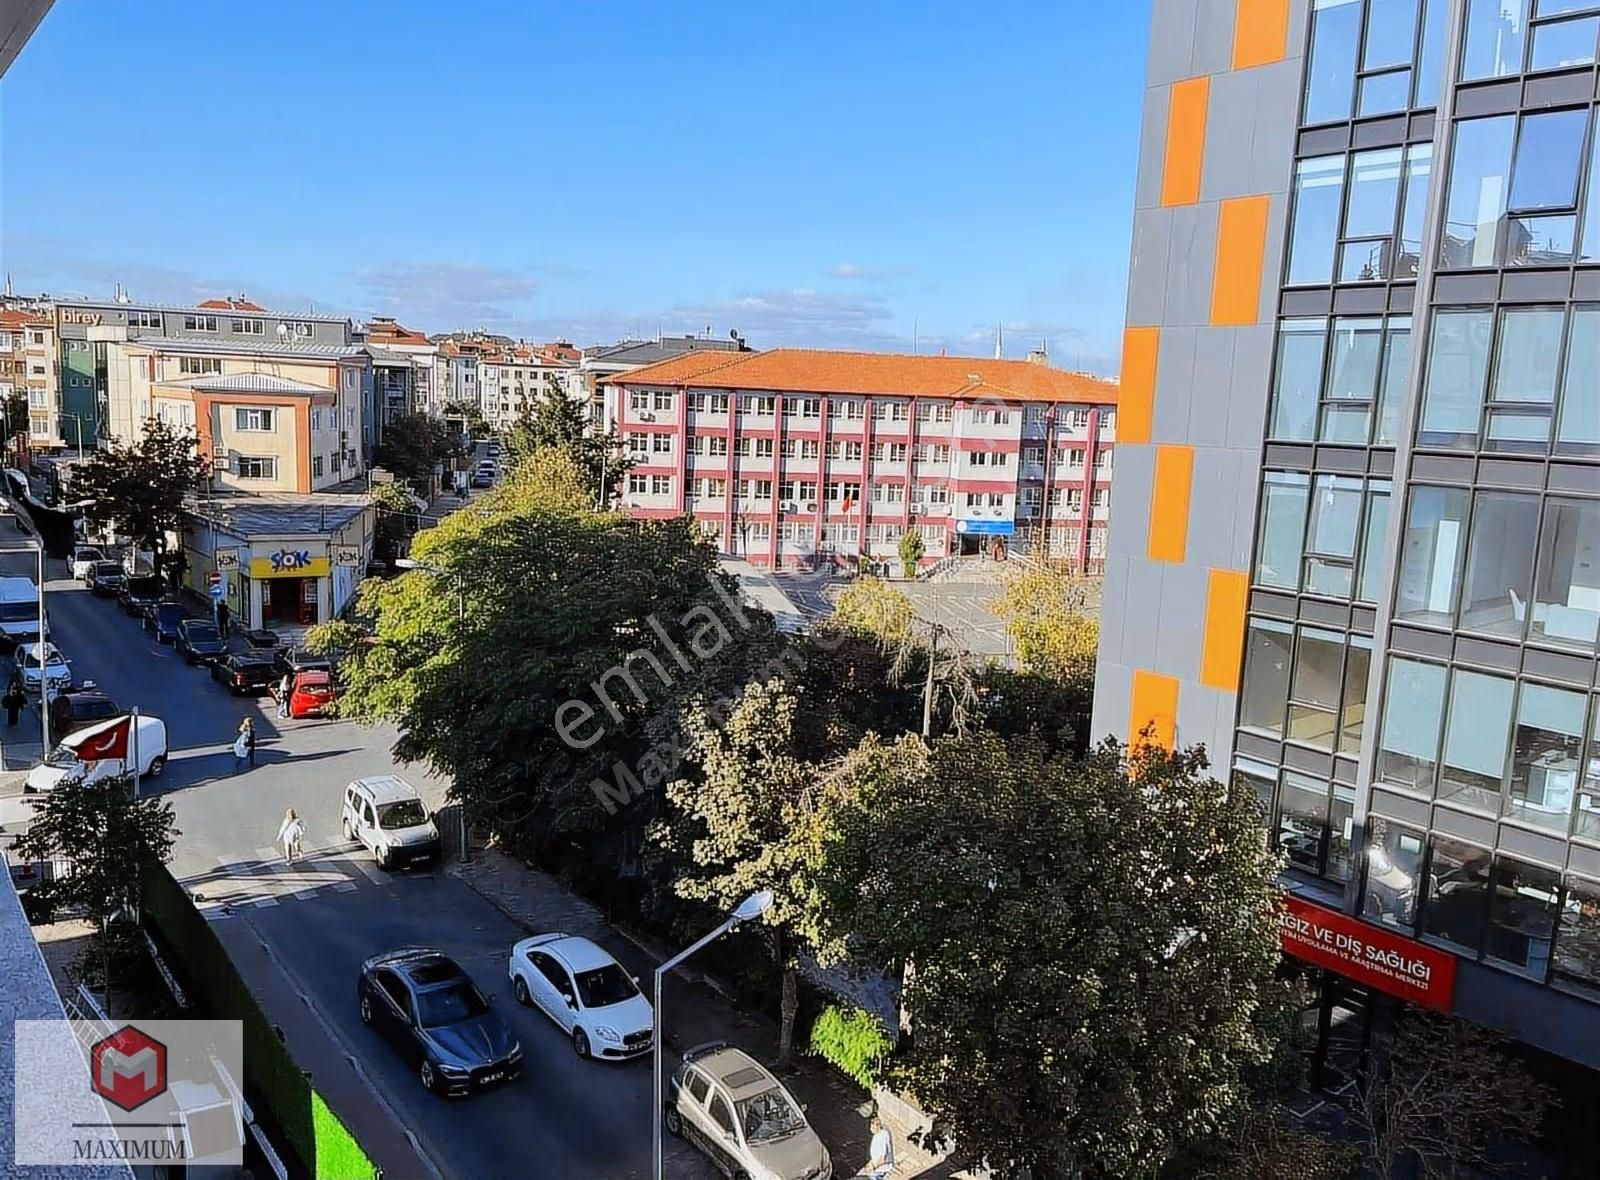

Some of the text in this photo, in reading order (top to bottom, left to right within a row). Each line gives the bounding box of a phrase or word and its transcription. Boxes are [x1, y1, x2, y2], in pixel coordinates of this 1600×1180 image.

[61, 308, 101, 326] birey
[1313, 924, 1334, 944] VE
[1336, 933, 1362, 956] DİŞ
[1366, 945, 1431, 981] SAĞLIĞI
